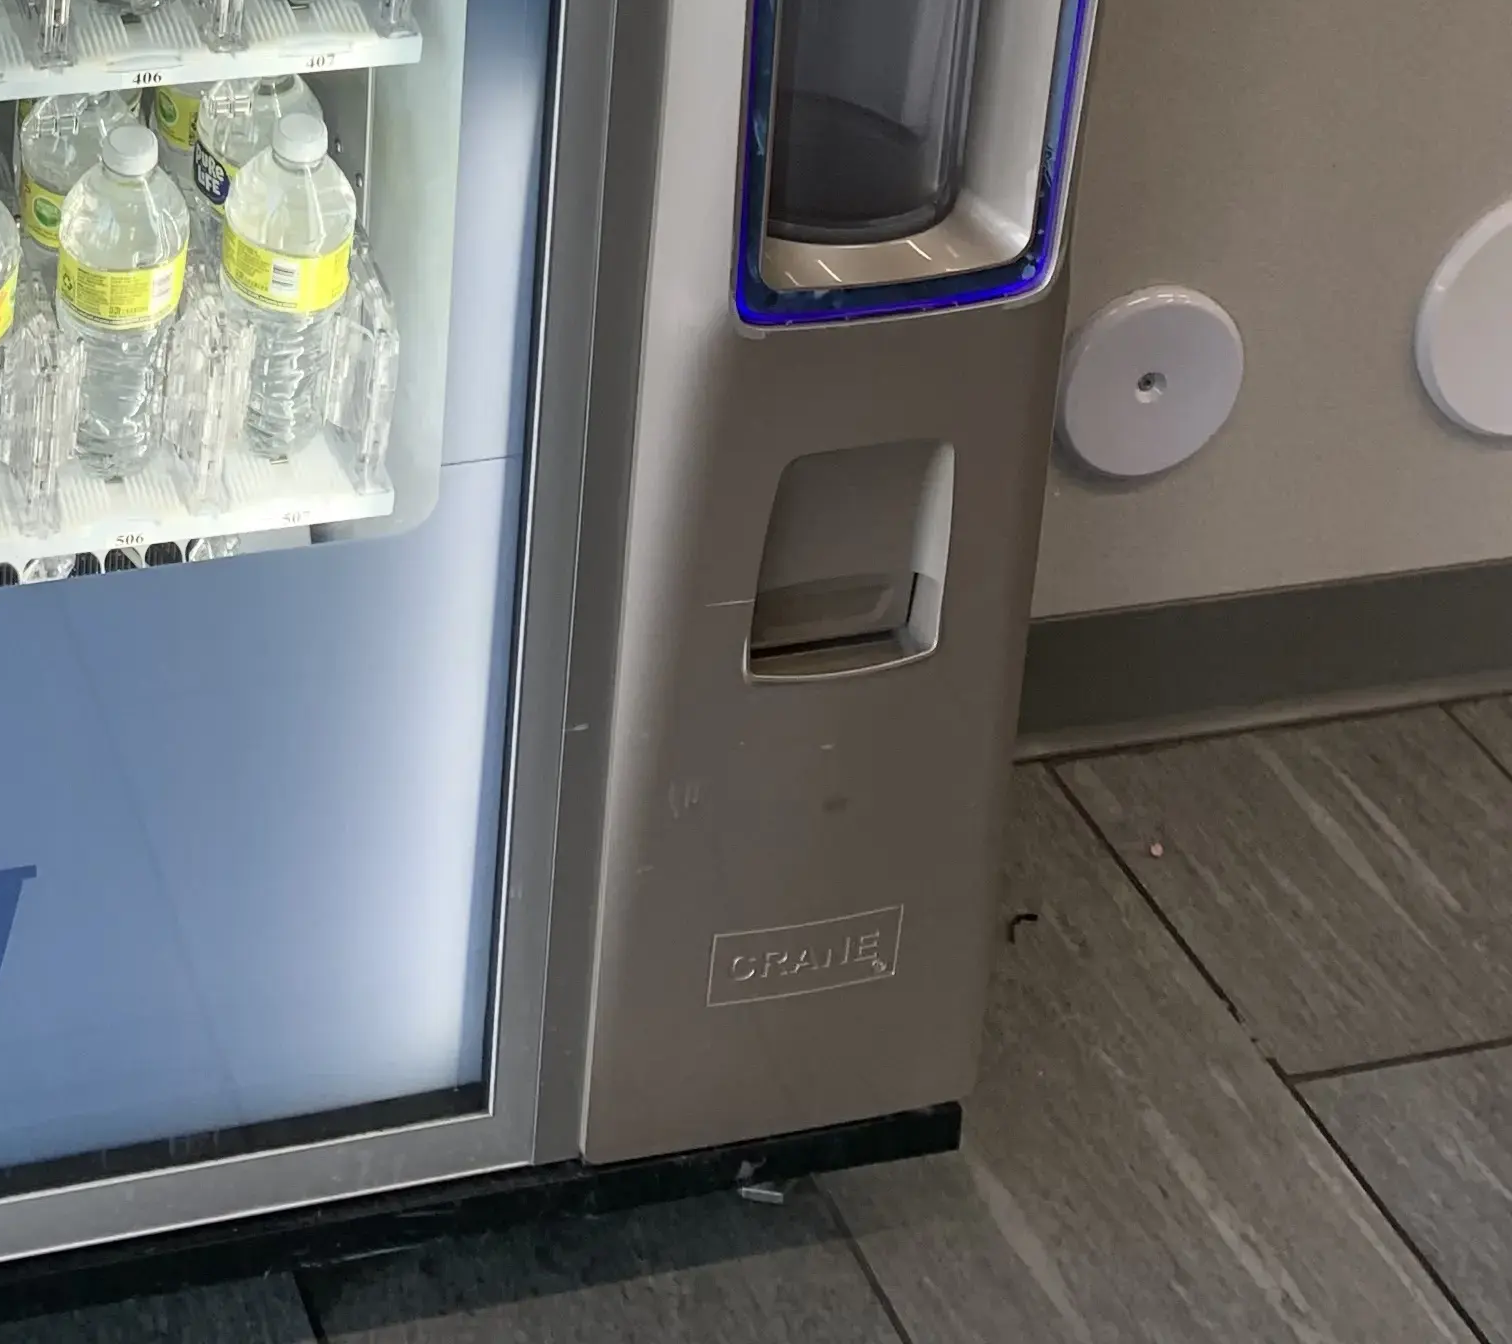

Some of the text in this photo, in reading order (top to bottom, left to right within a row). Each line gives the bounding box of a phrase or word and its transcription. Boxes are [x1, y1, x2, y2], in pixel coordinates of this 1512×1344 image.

[305, 54, 337, 69] 407
[131, 70, 163, 86] 406
[115, 533, 145, 546] 506
[731, 929, 881, 982] CRANE
